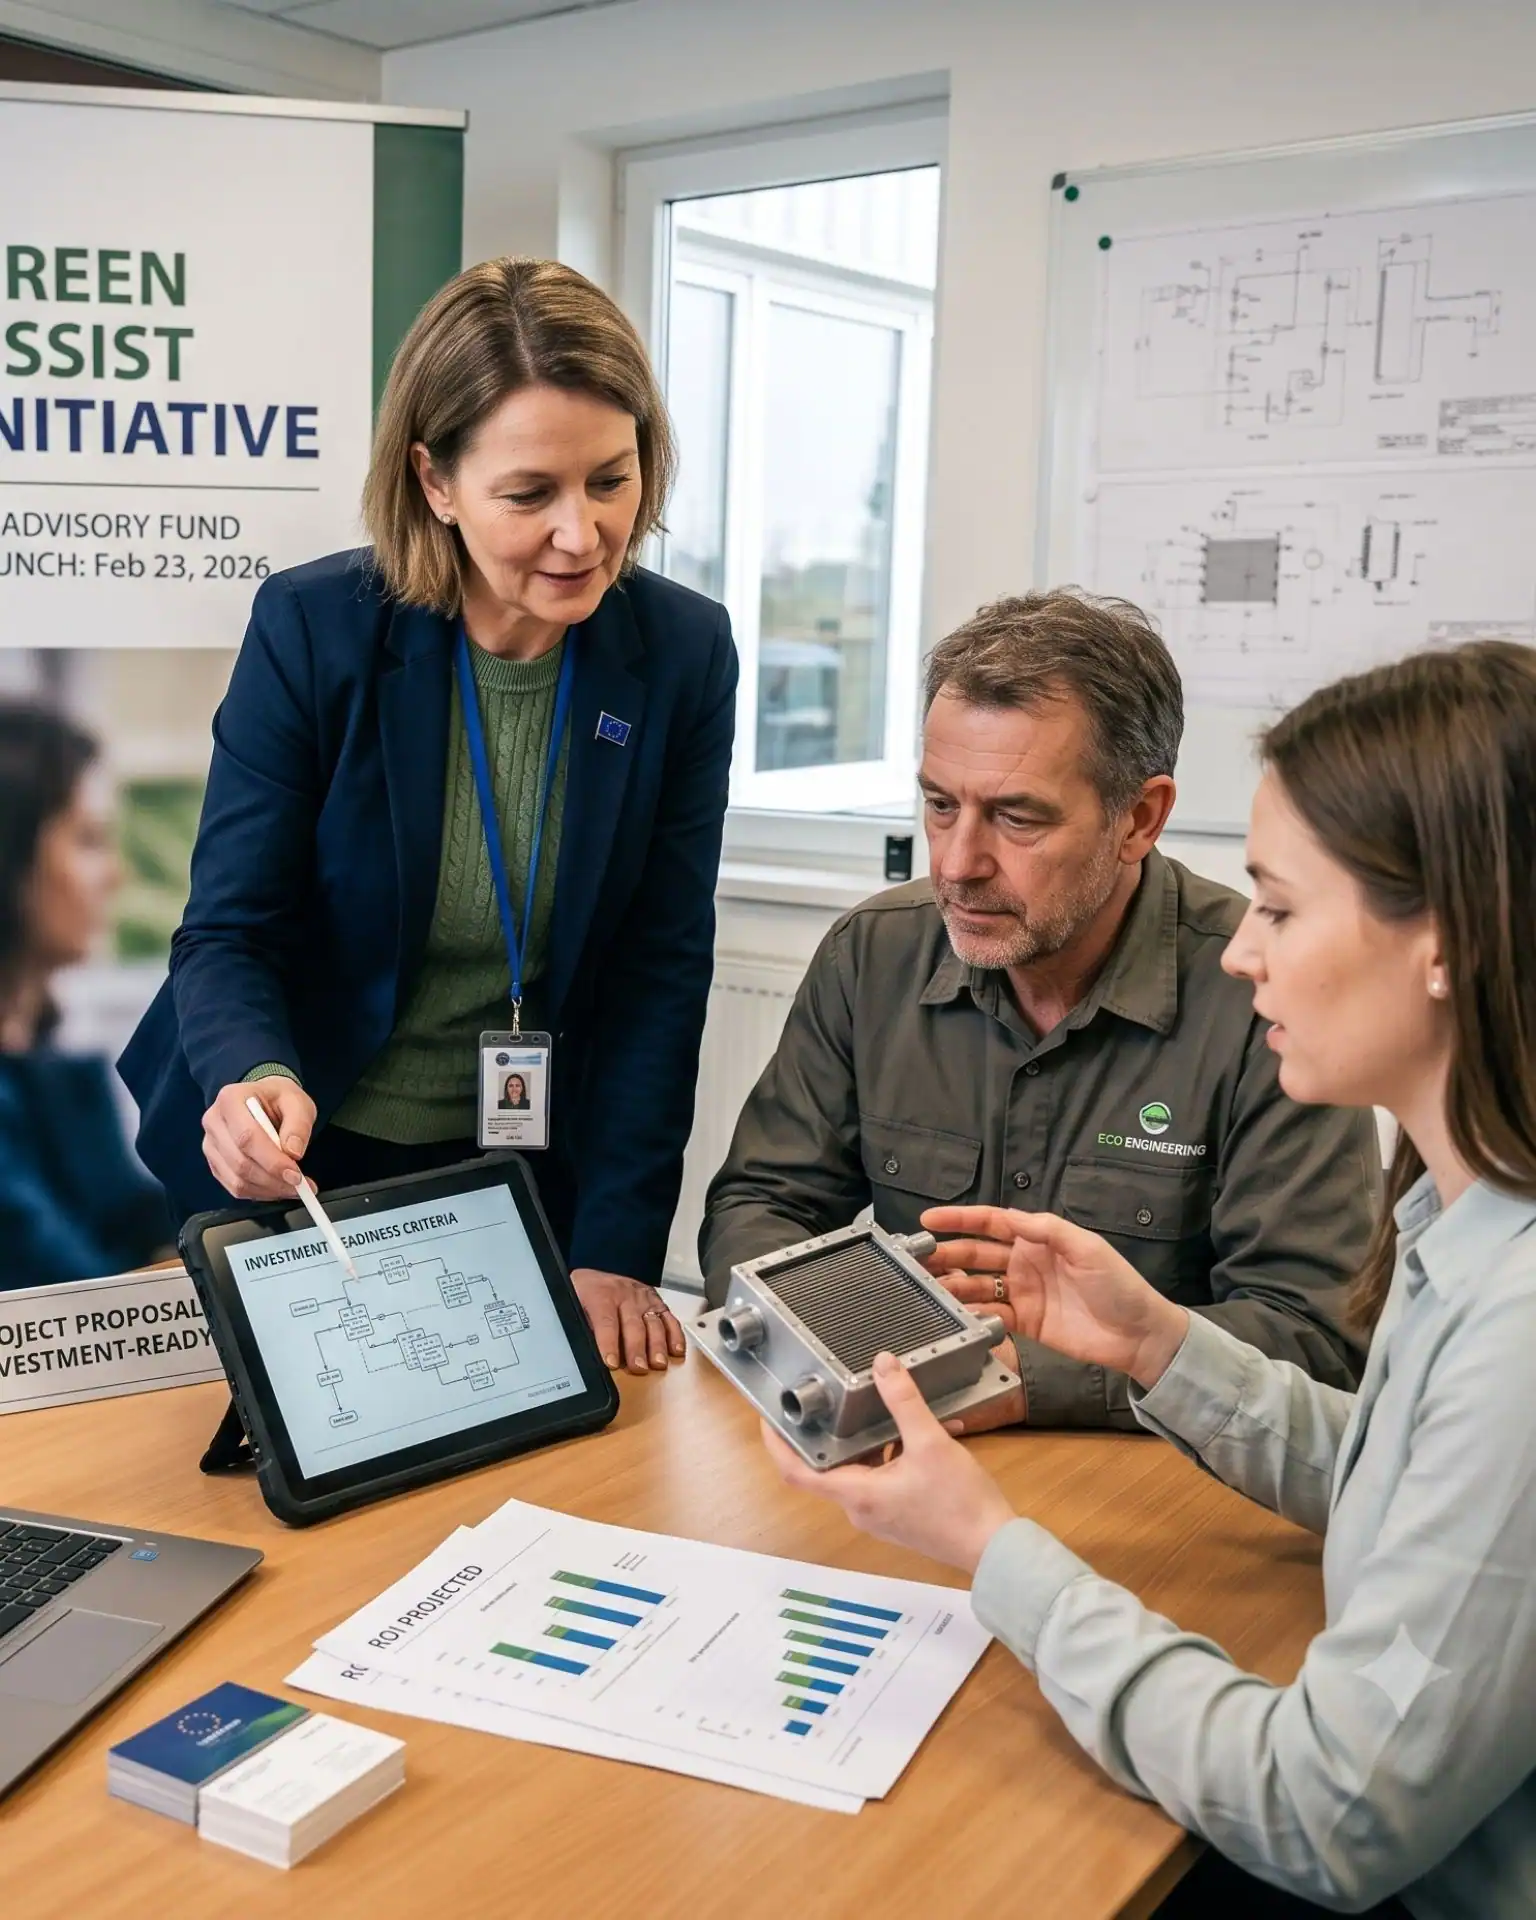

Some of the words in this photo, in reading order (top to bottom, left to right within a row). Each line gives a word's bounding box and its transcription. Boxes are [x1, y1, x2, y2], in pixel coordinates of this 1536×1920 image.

[7, 246, 186, 306] REEN
[5, 320, 195, 381] SSIST
[2, 512, 150, 539] ADVISORY
[160, 514, 241, 540] FUND
[0, 552, 85, 578] UNCH:
[95, 553, 146, 578] Feb
[154, 554, 194, 582] 23,
[203, 555, 271, 580] 2026
[1097, 1133, 1123, 1146] ECO
[1124, 1136, 1207, 1157] ENGINEERING
[244, 1240, 330, 1272] INVESTMENT
[341, 1225, 401, 1249] EADINESS
[402, 1211, 459, 1235] CRITERIA
[0, 1316, 67, 1349] OJECT
[75, 1298, 204, 1335] PROPOSAL
[368, 1625, 407, 1649] ROI
[397, 1565, 483, 1627] PROJECTED
